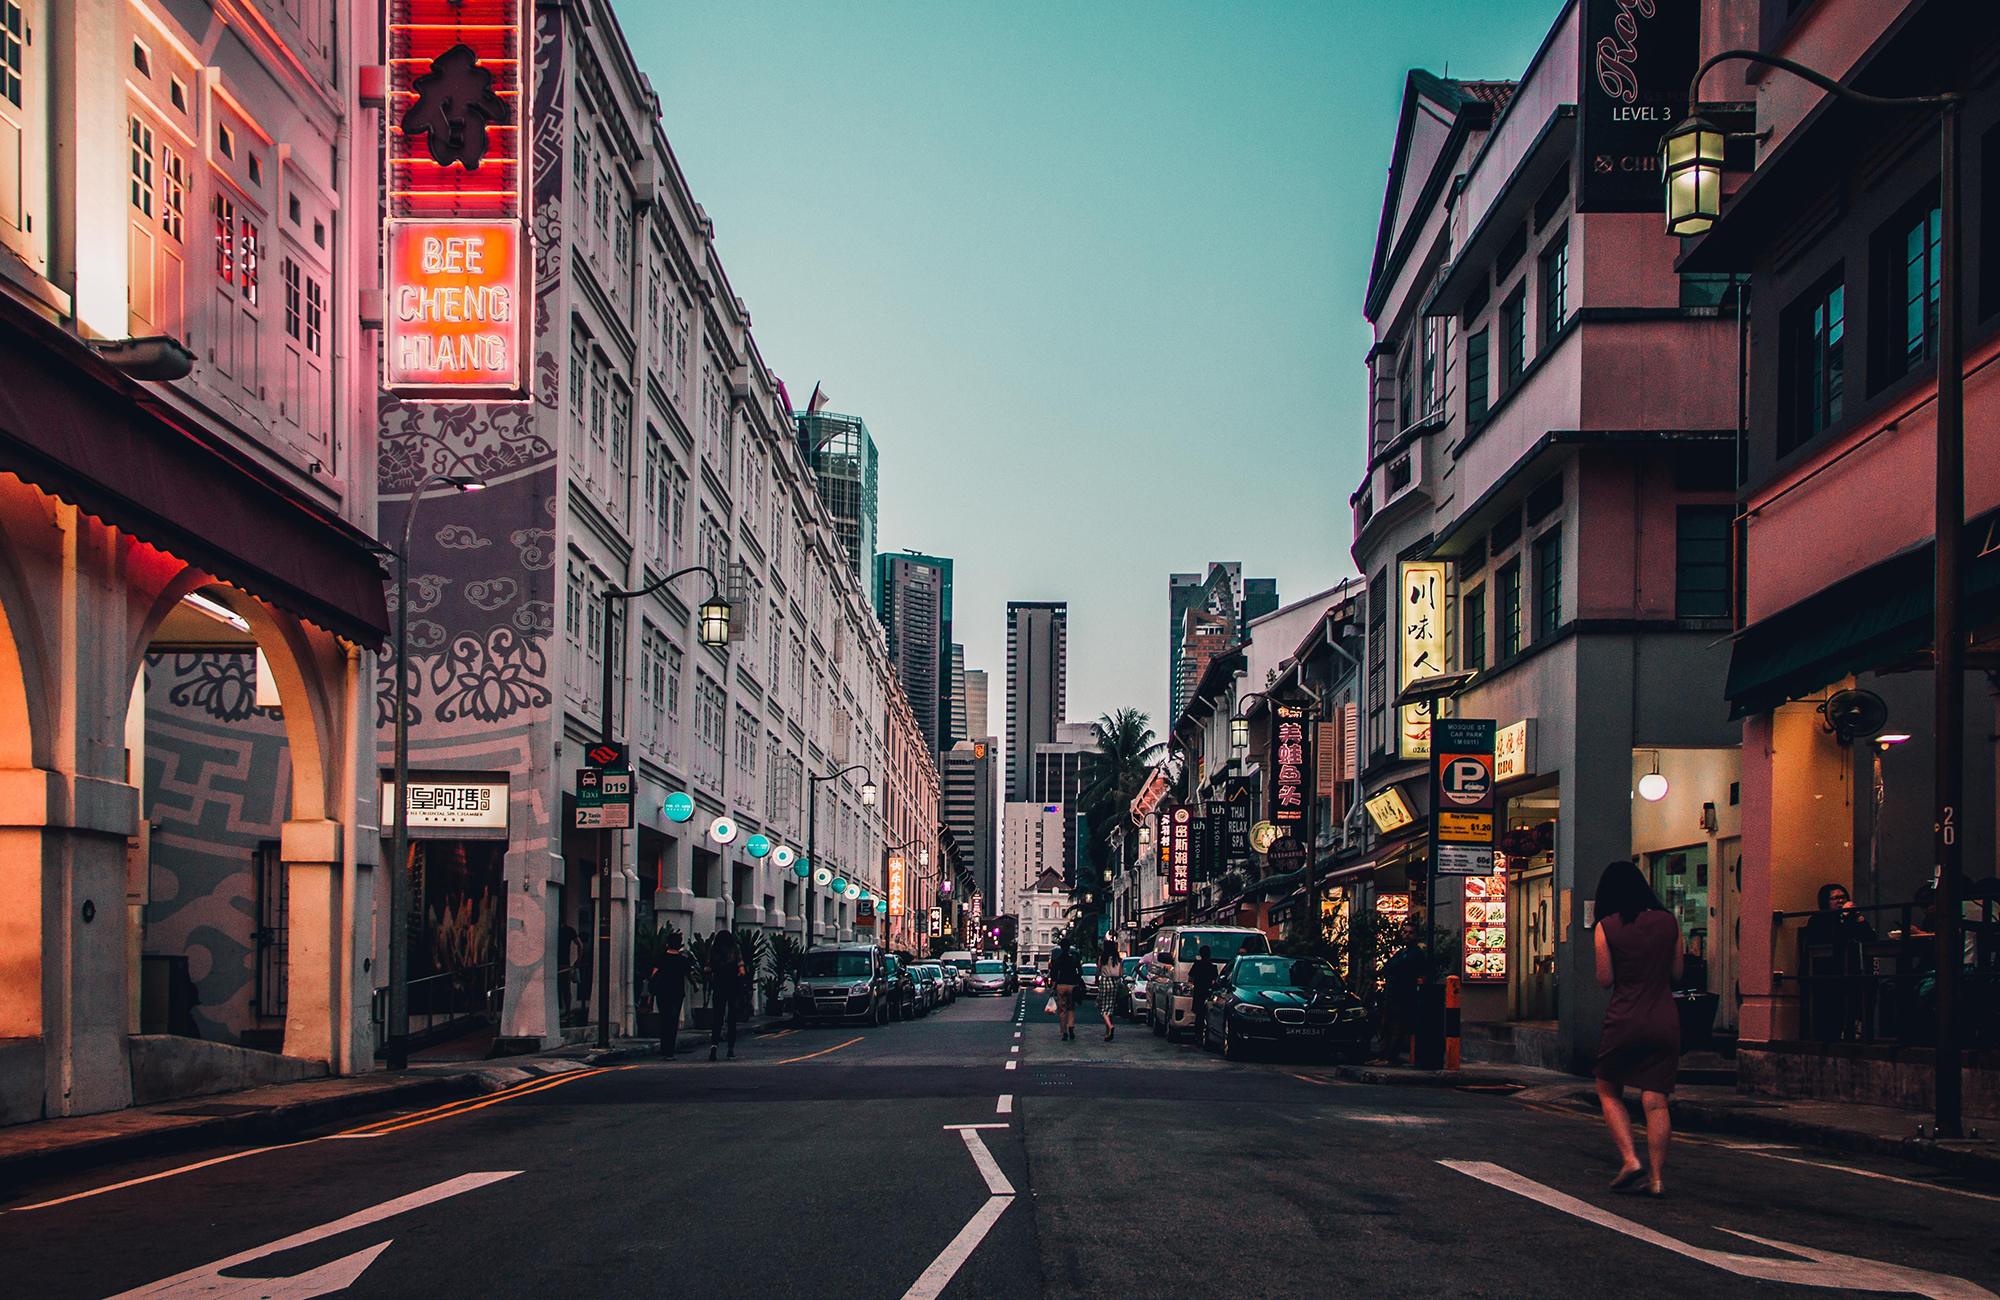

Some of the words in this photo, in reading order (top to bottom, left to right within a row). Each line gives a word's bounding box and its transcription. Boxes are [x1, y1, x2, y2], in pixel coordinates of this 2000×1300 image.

[1613, 106, 1658, 121] LEVEL
[1662, 106, 1672, 121] 3
[422, 236, 485, 274] BEE
[396, 284, 511, 323] CHENG
[398, 333, 507, 372] HIANG
[1447, 723, 1475, 731] MOSQUE
[1477, 723, 1488, 731] ST.
[1277, 722, 1303, 806] 美蛙鱼头
[1497, 758, 1513, 775] BBQ
[1453, 761, 1486, 791] P
[581, 789, 599, 799] Taxi
[604, 782, 627, 793] D19
[577, 810, 588, 825] 2
[1230, 806, 1246, 819] THAI
[1228, 820, 1248, 833] RELAX
[1470, 823, 1492, 832] $1.20
[1943, 805, 1955, 845] 20
[1231, 834, 1245, 848] SPA
[603, 857, 609, 876] 19
[1476, 856, 1491, 865] 60¢
[860, 902, 871, 913] P
